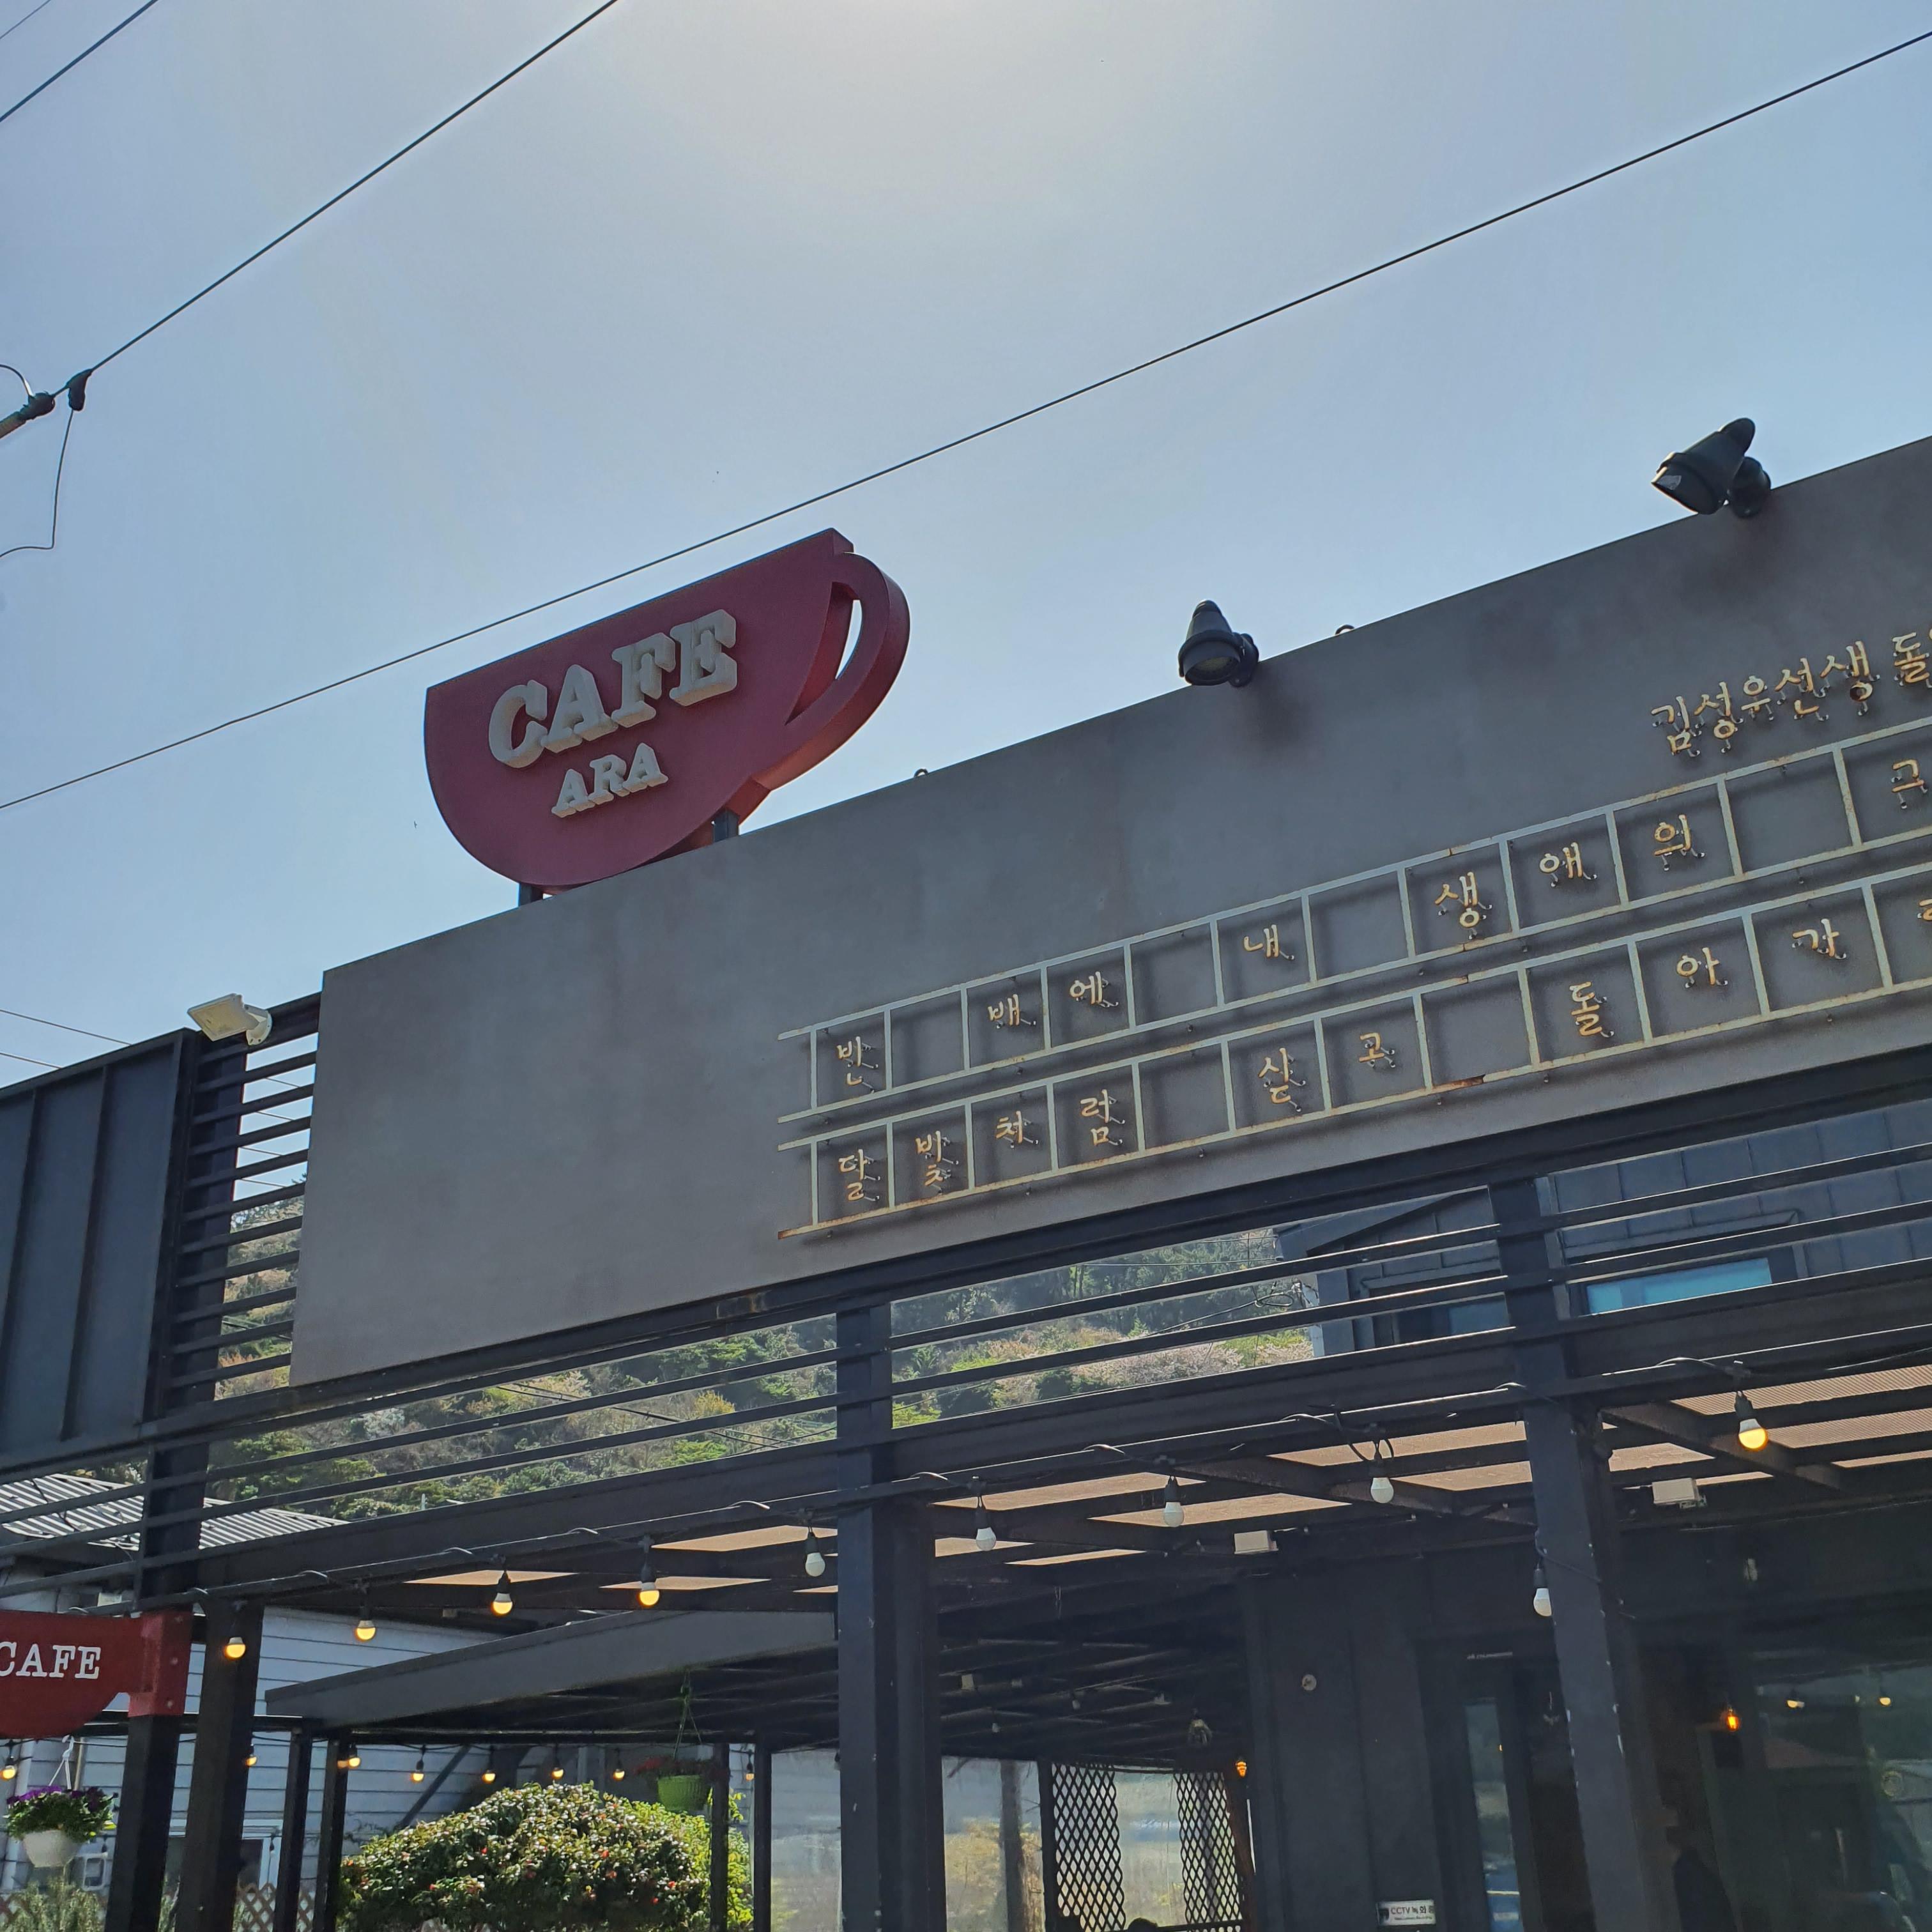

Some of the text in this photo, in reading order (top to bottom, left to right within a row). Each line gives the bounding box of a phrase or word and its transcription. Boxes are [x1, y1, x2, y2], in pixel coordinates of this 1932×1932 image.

[488, 609, 737, 768] CAFE
[551, 742, 668, 818] ARA
[836, 1036, 862, 1085] 빈
[1243, 924, 1280, 958] 내
[0, 1641, 101, 1680] CAFE
[1390, 1906, 1410, 1915] CCTV
